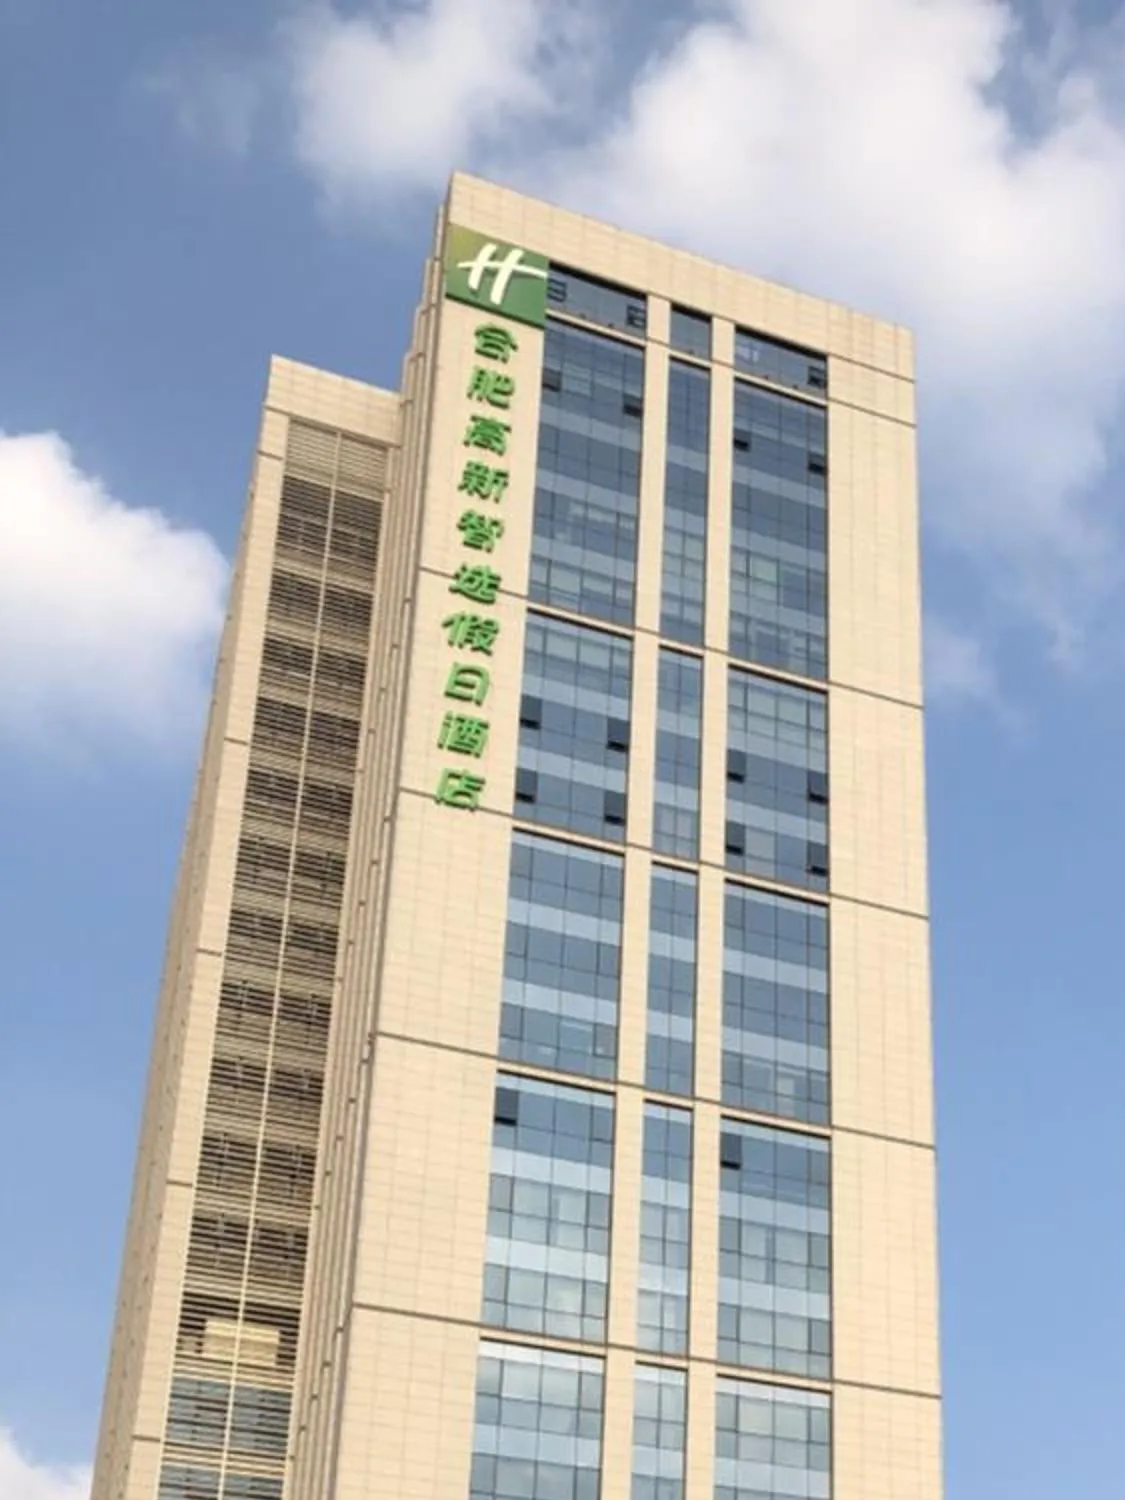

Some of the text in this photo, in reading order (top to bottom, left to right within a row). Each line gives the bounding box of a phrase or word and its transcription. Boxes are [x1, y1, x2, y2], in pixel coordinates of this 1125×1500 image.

[434, 323, 518, 812] 合肥高新智选假日酒店
